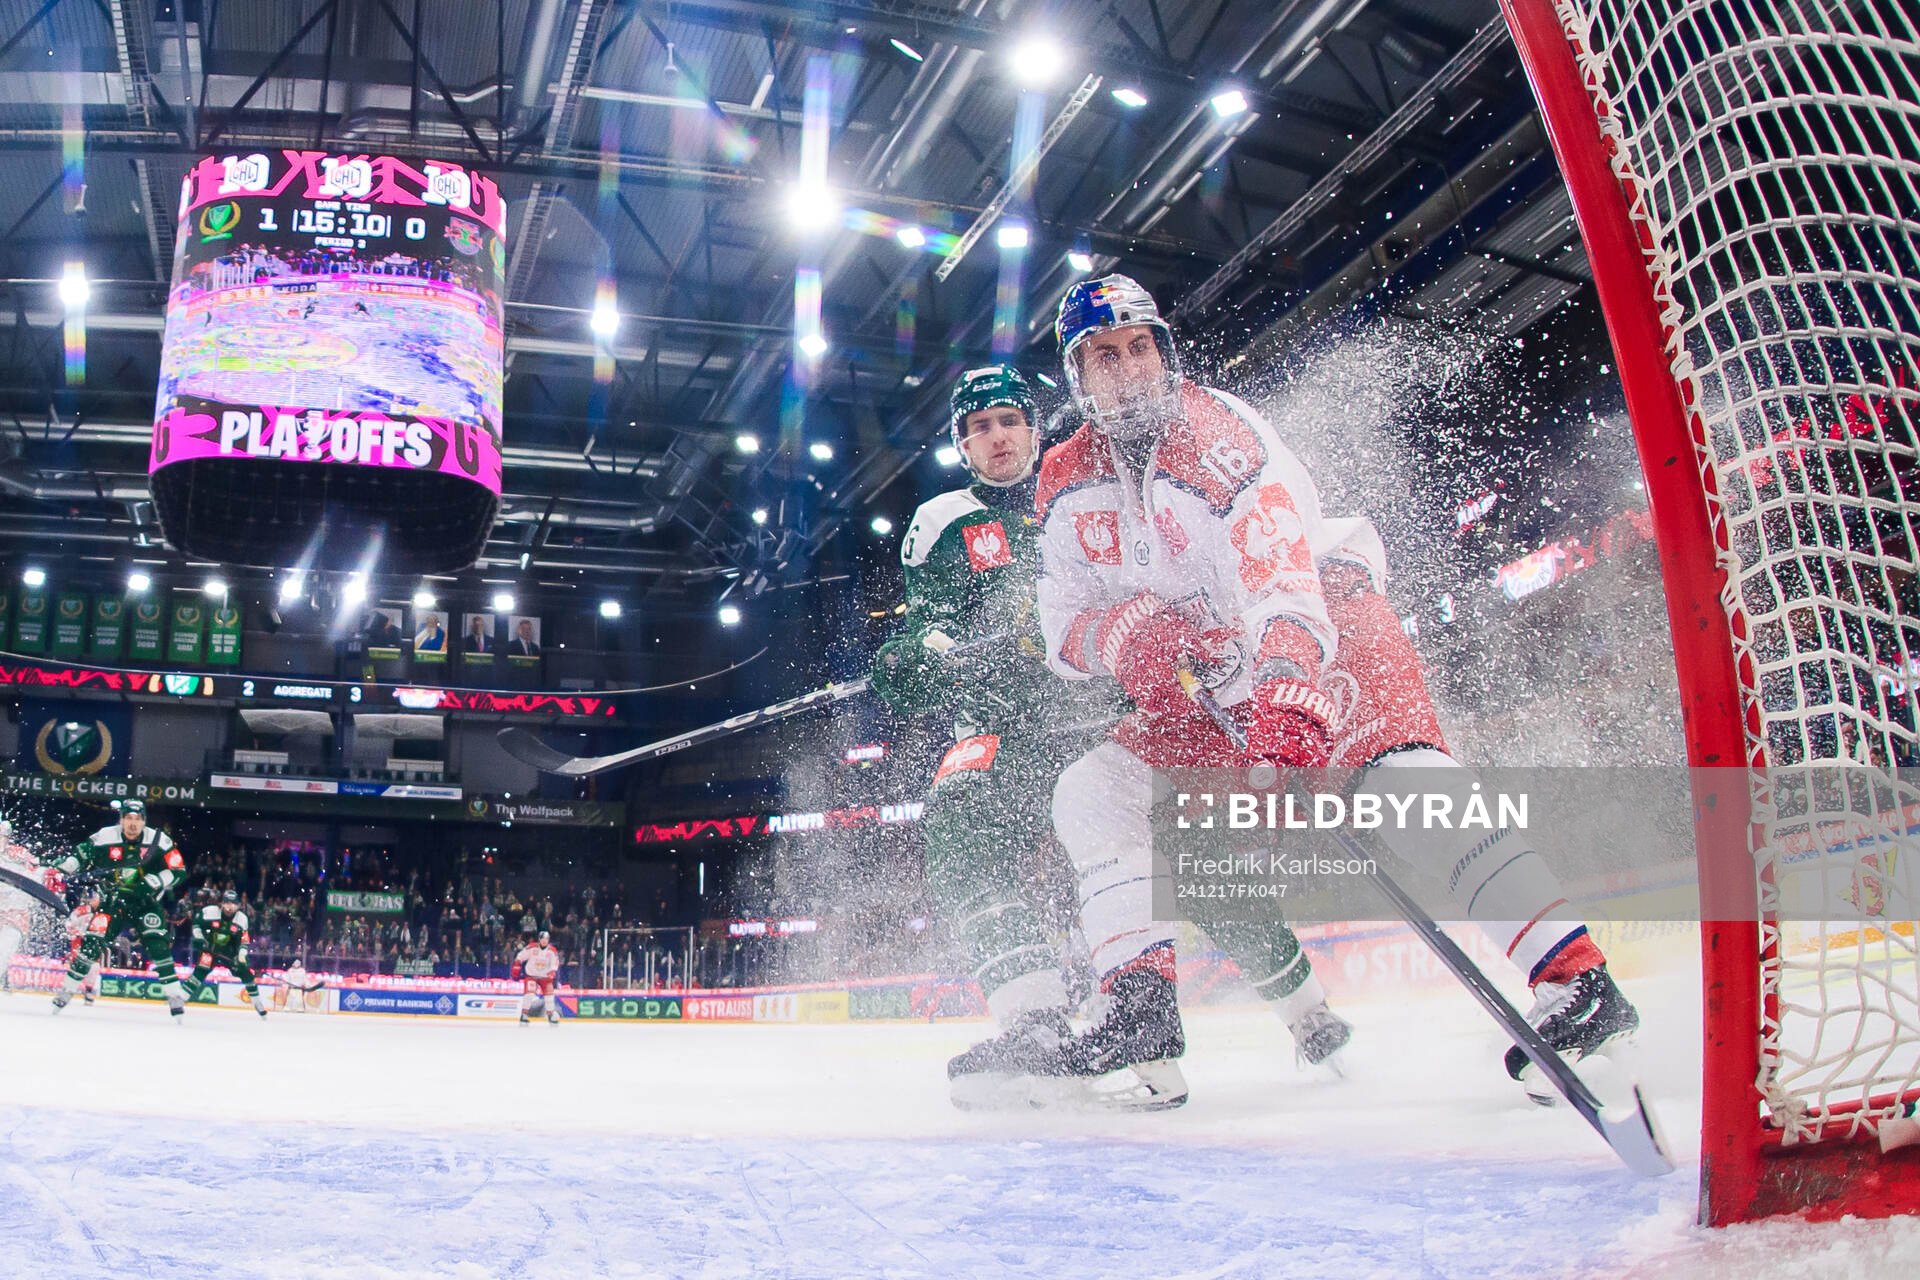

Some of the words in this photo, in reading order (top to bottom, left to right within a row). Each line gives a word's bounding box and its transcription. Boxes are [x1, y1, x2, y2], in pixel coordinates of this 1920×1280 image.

[258, 208, 278, 231] 1
[405, 218, 426, 240] 0
[1199, 440, 1248, 493] 16
[242, 680, 254, 696] 2
[274, 685, 333, 698] AGGREGATE
[350, 686, 362, 702] 3
[7, 776, 43, 790] THE
[52, 779, 127, 797] LOCKER
[137, 785, 195, 800] ROOM
[495, 804, 517, 815] The
[520, 805, 574, 818] Wolfpack
[101, 980, 217, 1001] SKOA
[701, 999, 752, 1019] STRAUSS
